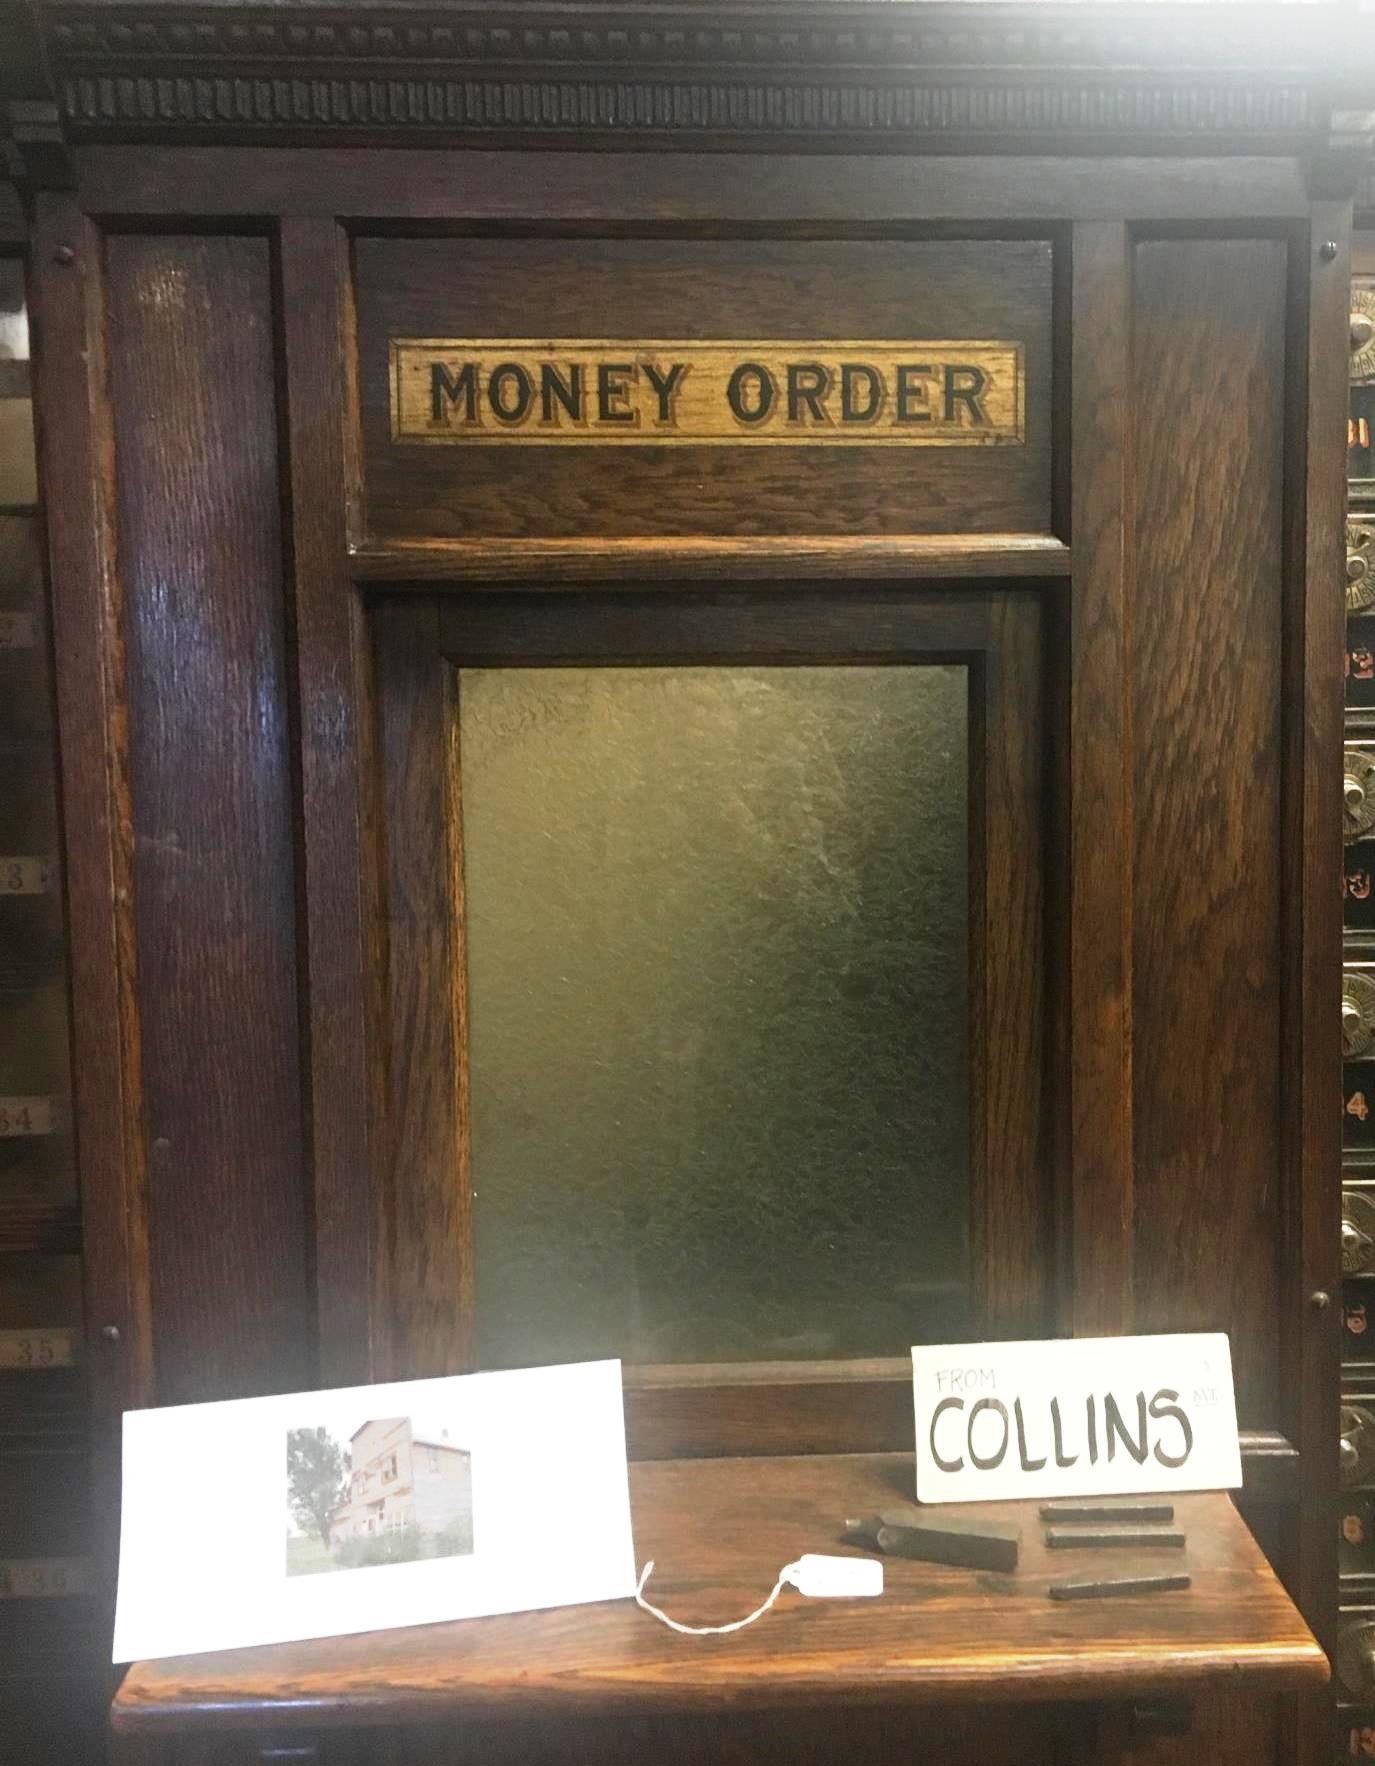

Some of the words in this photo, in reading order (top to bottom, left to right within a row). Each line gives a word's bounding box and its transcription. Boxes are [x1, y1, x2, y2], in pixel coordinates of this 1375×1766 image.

[427, 361, 693, 428] MONEY
[726, 361, 996, 428] ORDER
[935, 1367, 997, 1393] FROM
[929, 1388, 1194, 1473] COLLINS
